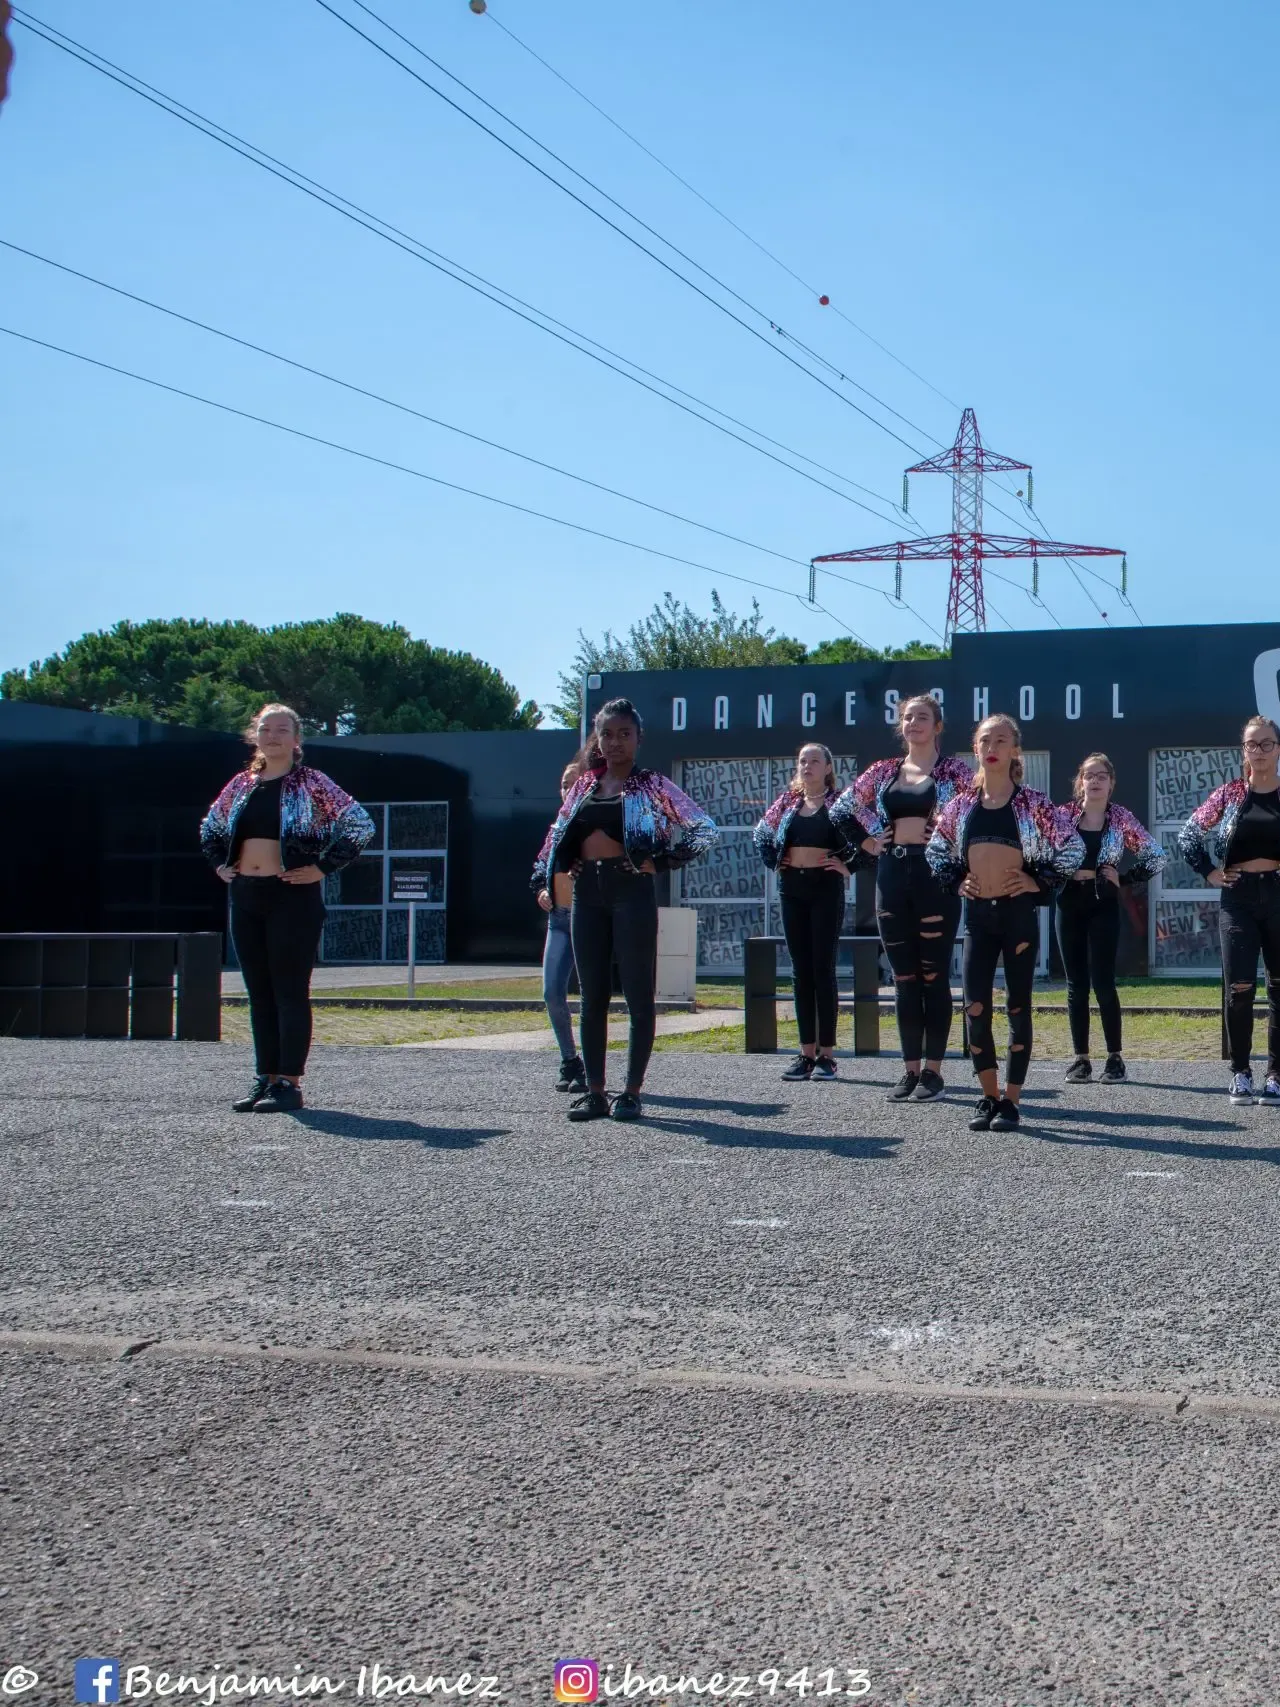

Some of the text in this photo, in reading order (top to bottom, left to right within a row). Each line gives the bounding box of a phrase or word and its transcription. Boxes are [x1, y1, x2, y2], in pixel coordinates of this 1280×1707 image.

[729, 760, 764, 778] NEW
[720, 774, 766, 797] STYLE
[1156, 775, 1192, 795] NEW
[1156, 915, 1194, 937] NEW
